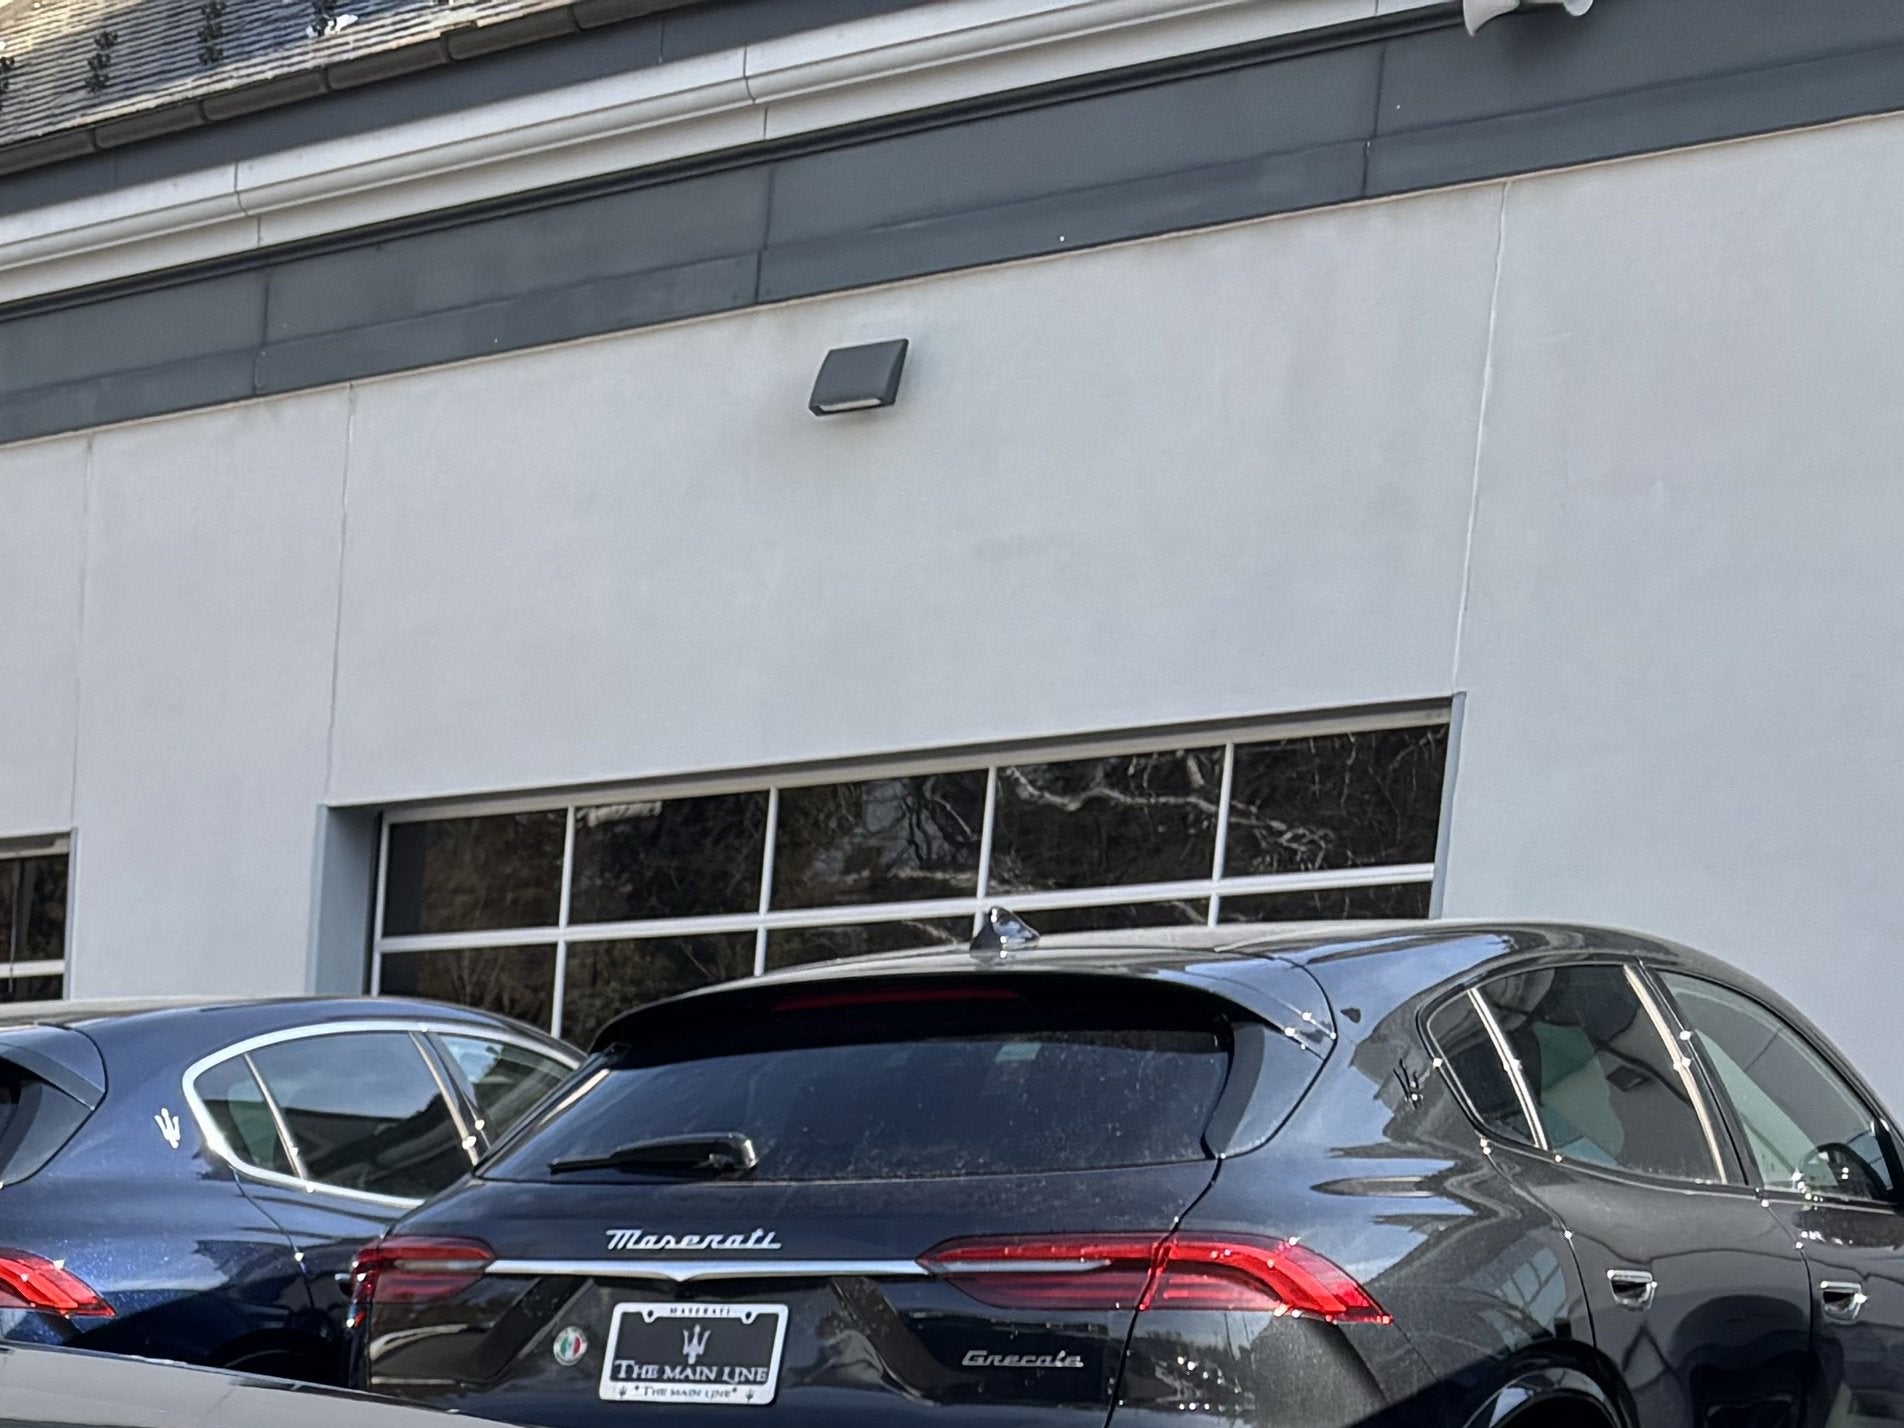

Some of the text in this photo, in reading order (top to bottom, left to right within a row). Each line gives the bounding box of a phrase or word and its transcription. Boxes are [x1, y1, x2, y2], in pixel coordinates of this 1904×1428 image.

[606, 1228, 782, 1250] Maserati
[961, 1350, 1084, 1368] Grecale
[614, 1360, 769, 1385] THE MAIN LINE
